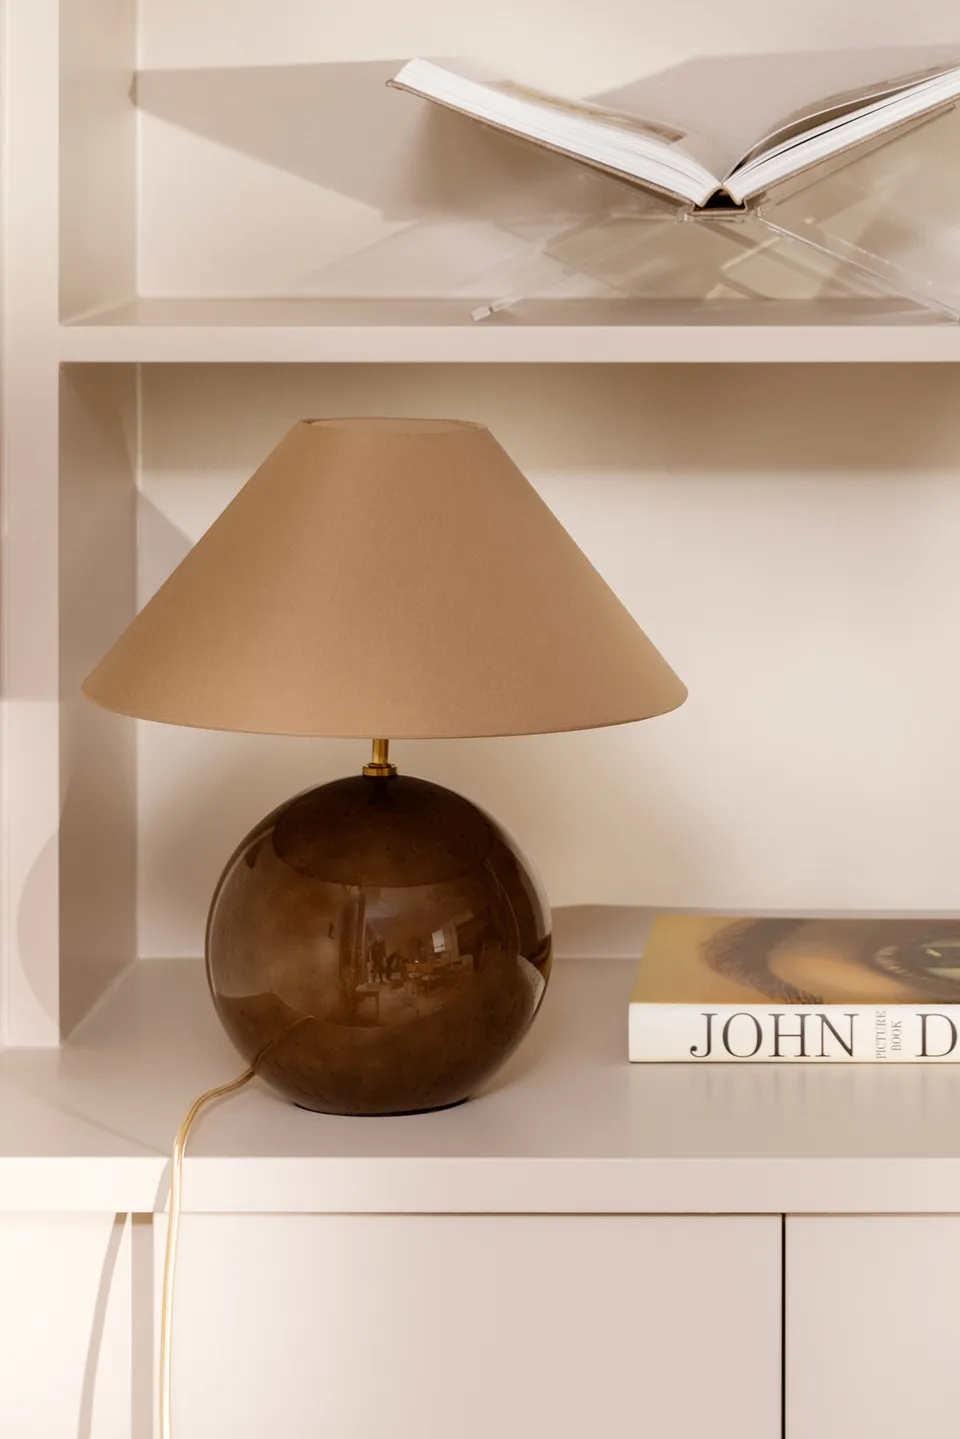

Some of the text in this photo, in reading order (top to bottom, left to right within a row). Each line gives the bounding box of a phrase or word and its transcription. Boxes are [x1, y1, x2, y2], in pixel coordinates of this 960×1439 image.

[689, 1012, 858, 1058] JOHN
[875, 1010, 887, 1060] PICTURE
[890, 1020, 903, 1051] BOOK
